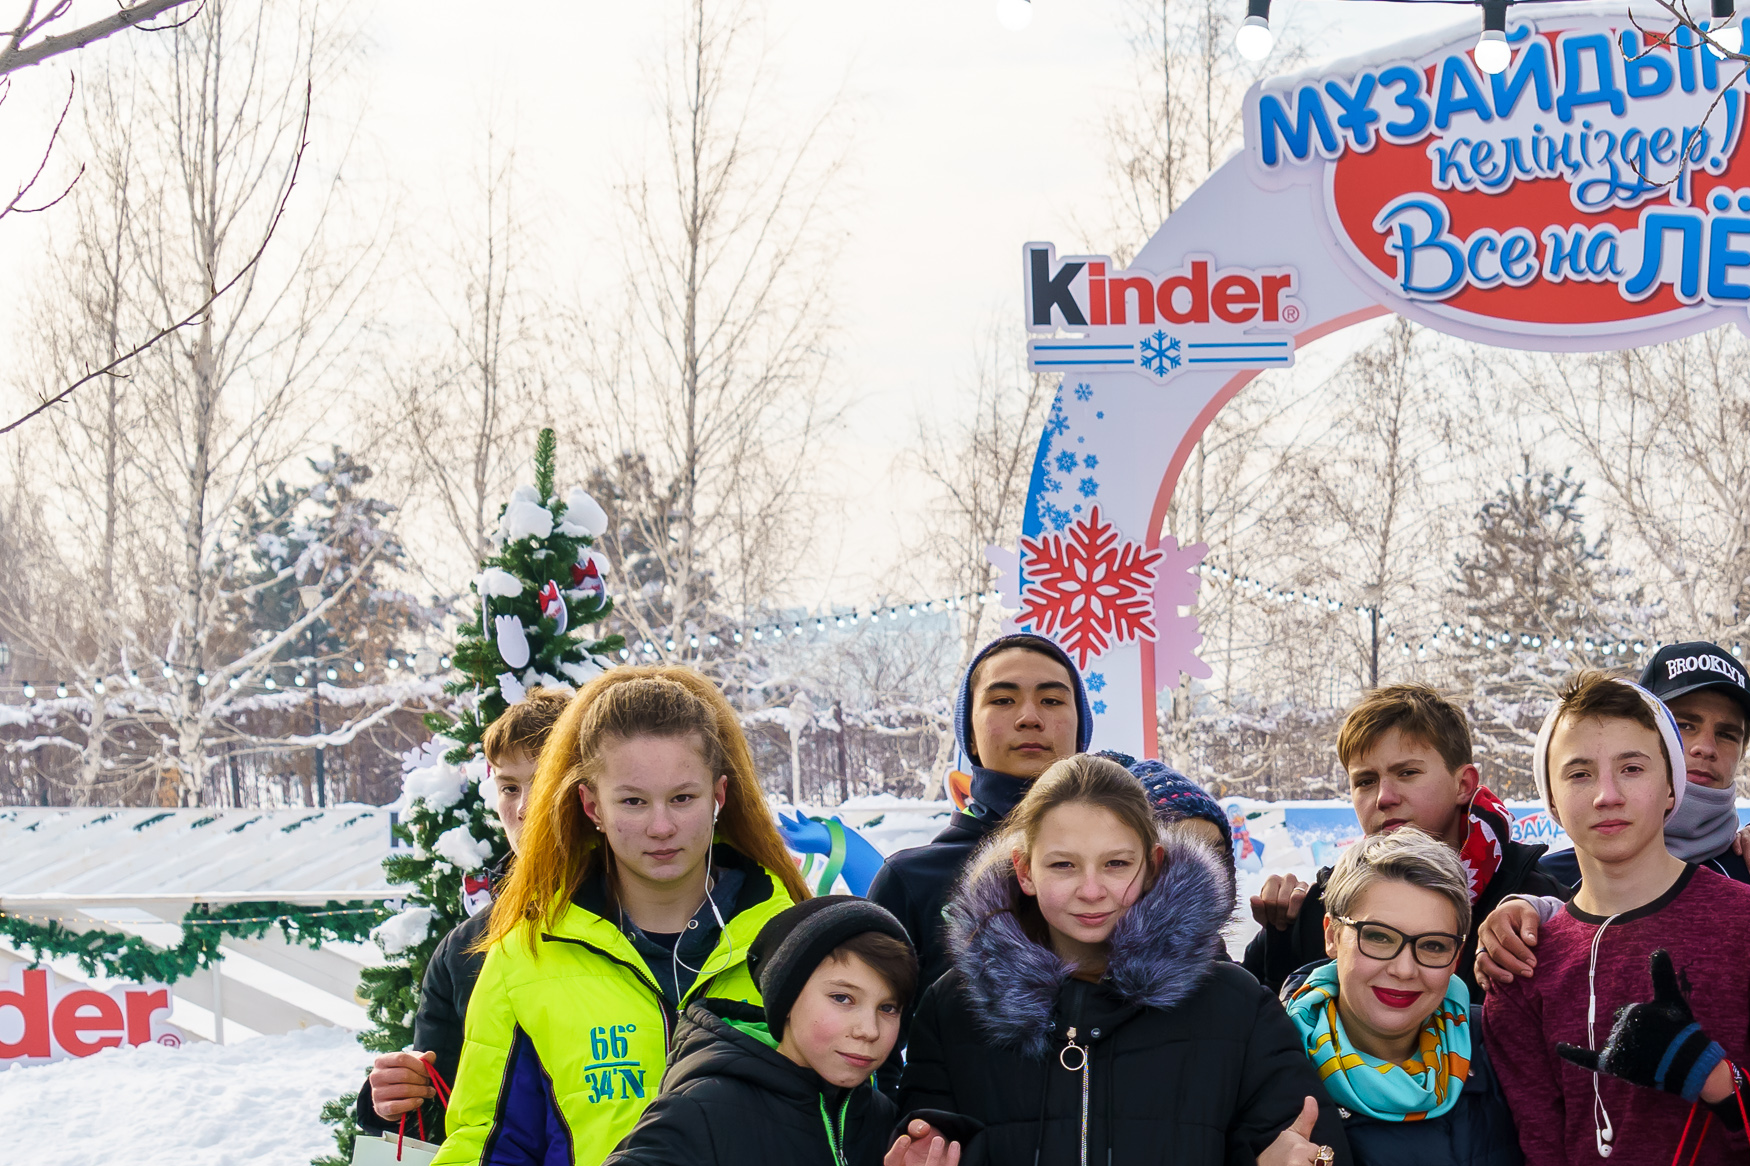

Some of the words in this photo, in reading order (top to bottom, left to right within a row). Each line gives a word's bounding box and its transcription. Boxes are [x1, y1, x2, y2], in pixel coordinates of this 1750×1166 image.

[1379, 198, 1534, 294] Все
[1549, 230, 1625, 277] на
[1666, 653, 1746, 688] BROOKLYN
